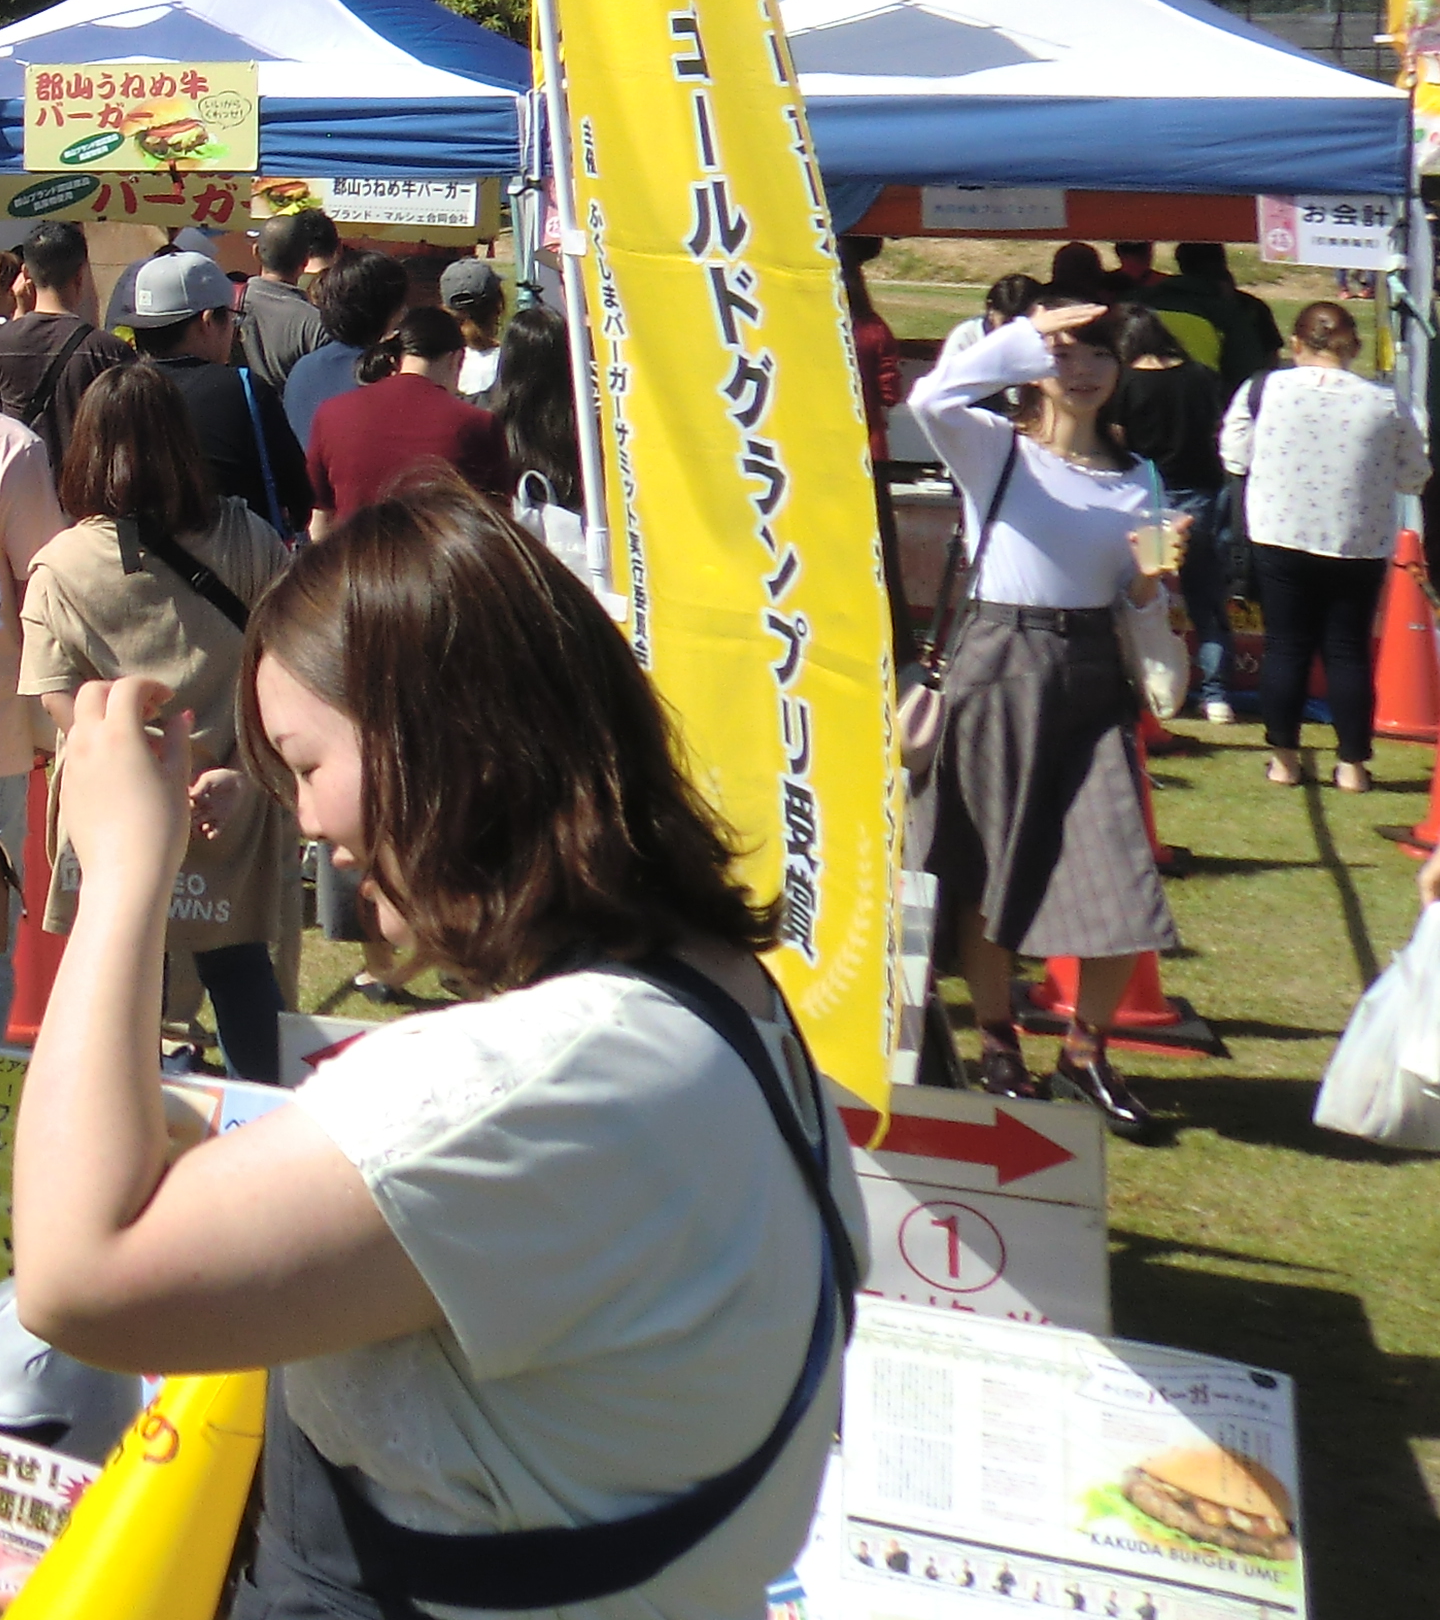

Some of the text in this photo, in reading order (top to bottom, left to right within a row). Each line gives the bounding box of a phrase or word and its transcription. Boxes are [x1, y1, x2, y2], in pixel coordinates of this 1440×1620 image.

[35, 70, 209, 100] 郡山うねめ牛
[34, 101, 154, 128] バーガー
[90, 176, 252, 224] バーガ
[332, 178, 472, 200] 郡山うねめ牛バーガー
[1302, 203, 1390, 227] お会計
[1090, 1531, 1164, 1557] KAKUDA
[1169, 1548, 1239, 1574] BURGER
